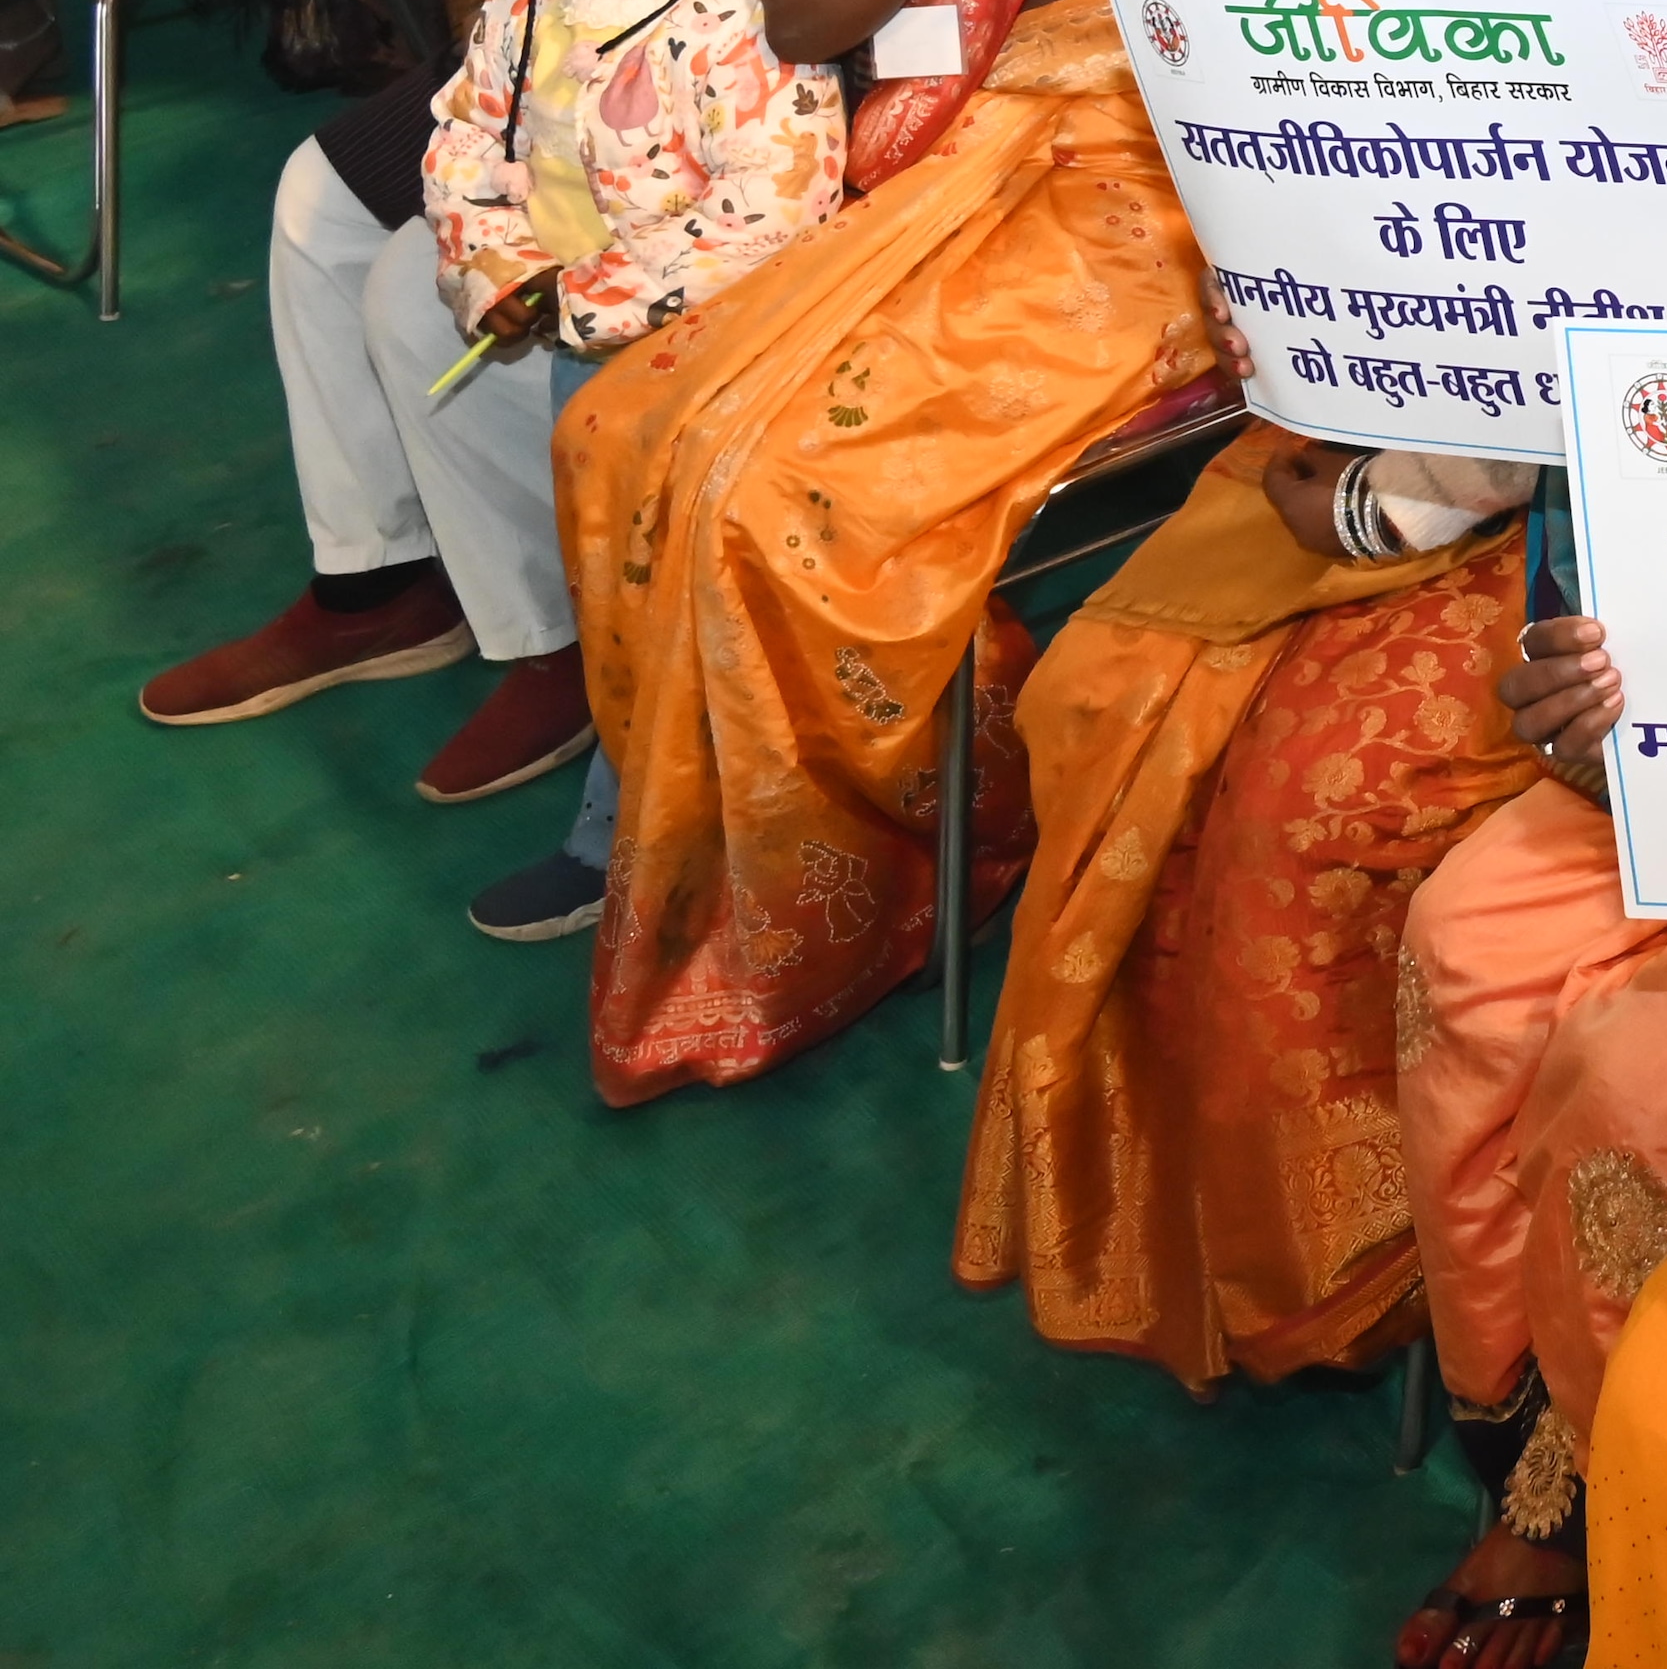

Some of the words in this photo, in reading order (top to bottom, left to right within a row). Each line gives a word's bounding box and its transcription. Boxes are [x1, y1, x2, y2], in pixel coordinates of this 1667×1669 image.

[1251, 71, 1305, 99] ग्रामीण
[1310, 73, 1370, 99] विकास
[1374, 72, 1444, 104] विभाग,
[1446, 74, 1503, 101] बिहार
[1505, 81, 1573, 102] सरकार
[1373, 201, 1423, 258] के
[1432, 201, 1526, 264] लिए
[1340, 282, 1519, 337] मुख्यमंत्री
[1286, 337, 1339, 388] को
[1342, 354, 1527, 416] बहुत-बहुत
